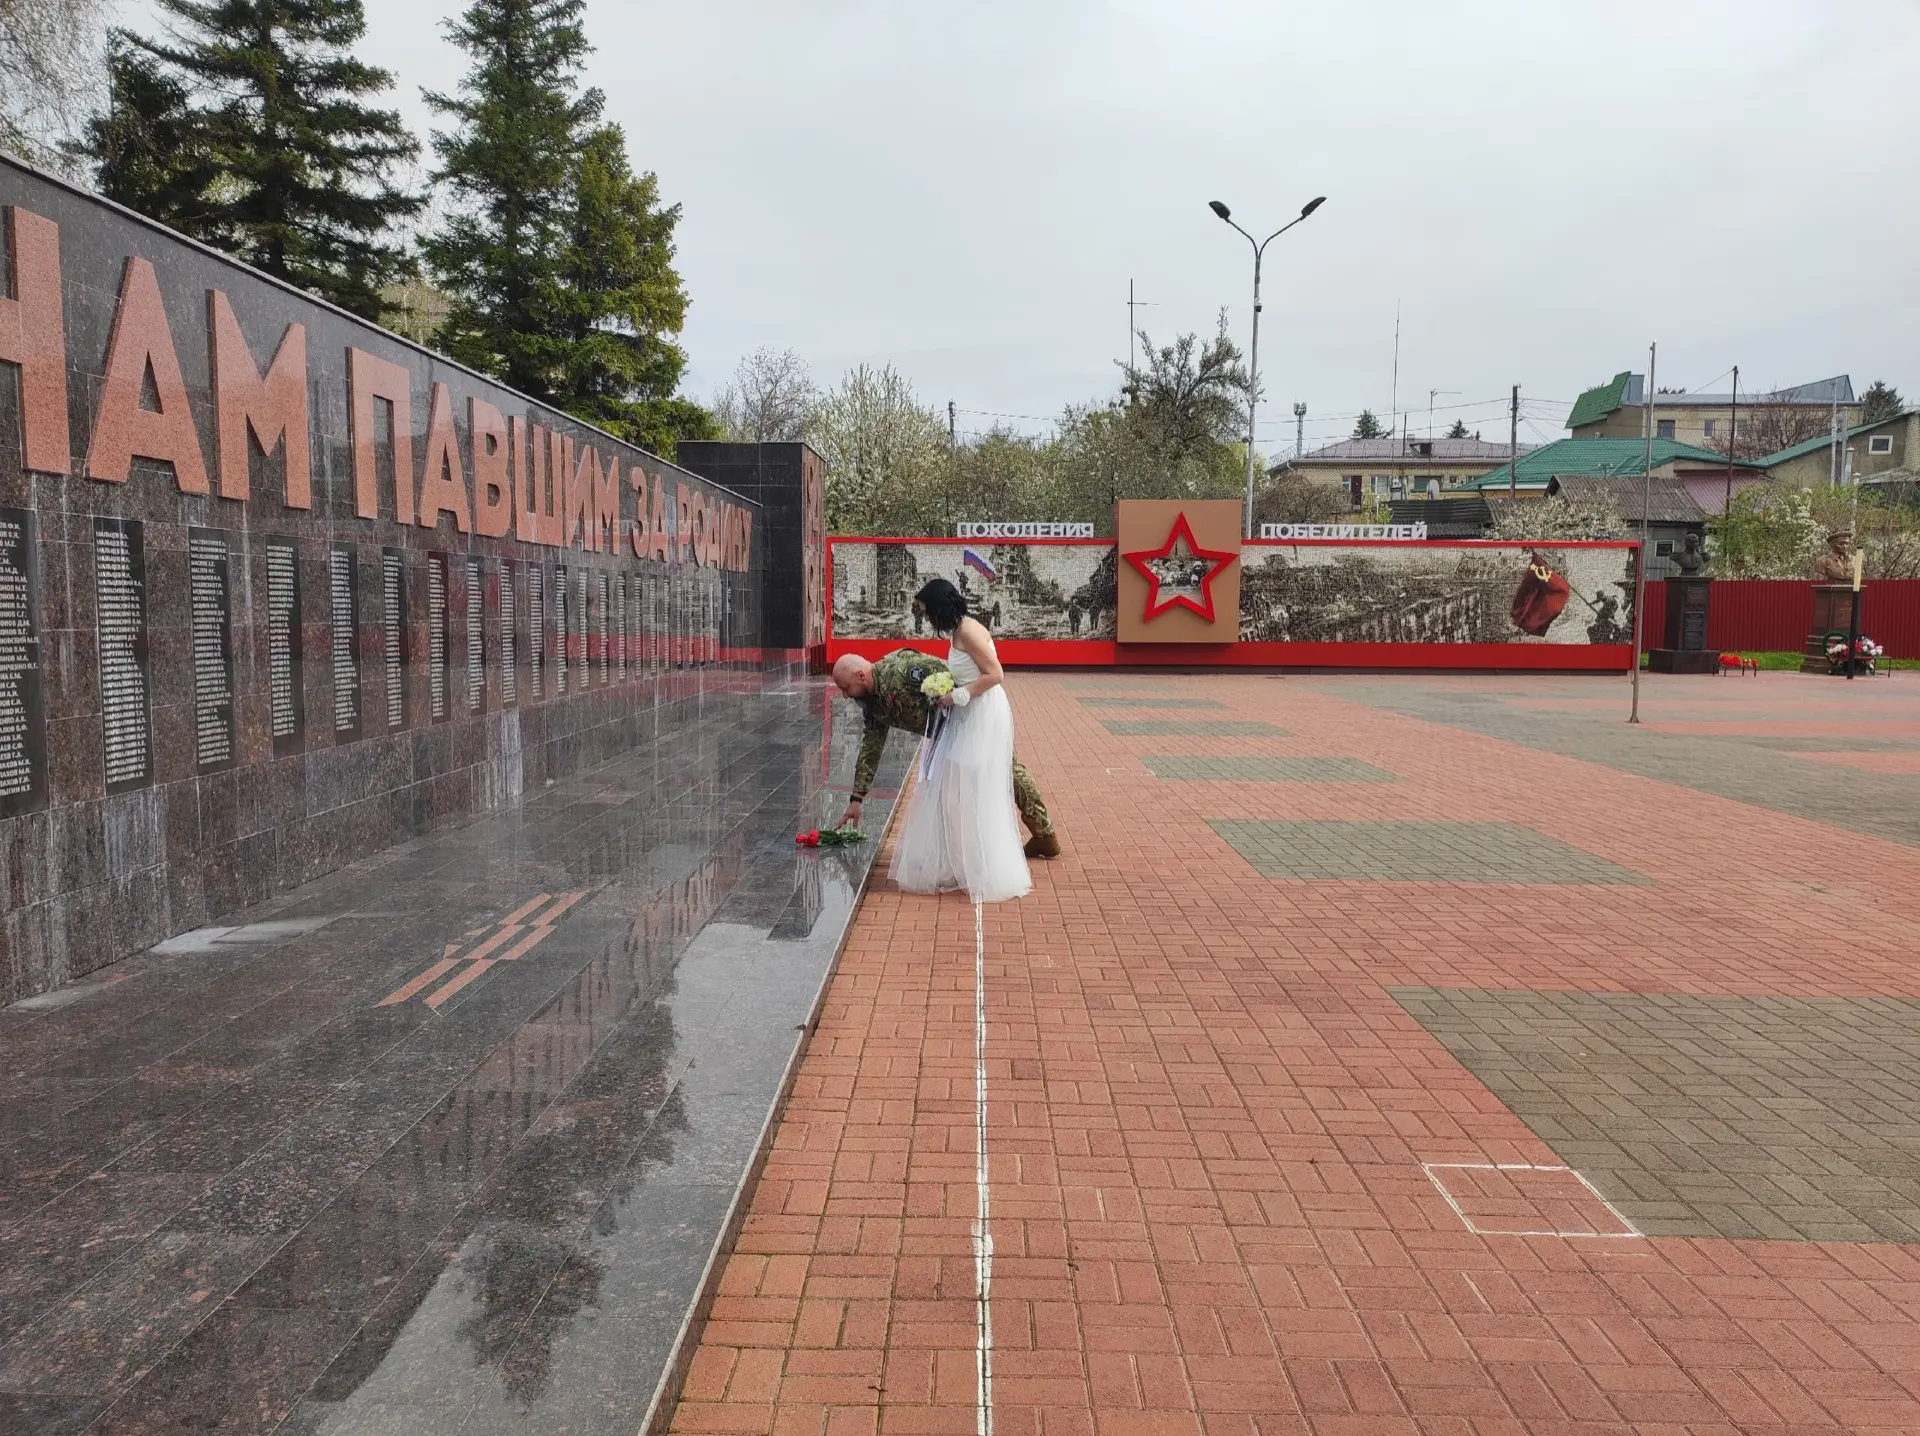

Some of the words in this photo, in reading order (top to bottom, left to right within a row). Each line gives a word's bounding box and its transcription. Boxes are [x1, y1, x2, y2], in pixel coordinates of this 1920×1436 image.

[345, 346, 620, 556] ПАВШИМ
[630, 466, 668, 562] ЗА
[677, 483, 752, 574] РОДИНУ
[957, 522, 1094, 537] ПОКОЛЕНИЯ
[1261, 521, 1427, 540] ПОБЕДИТЕЛЕЙ
